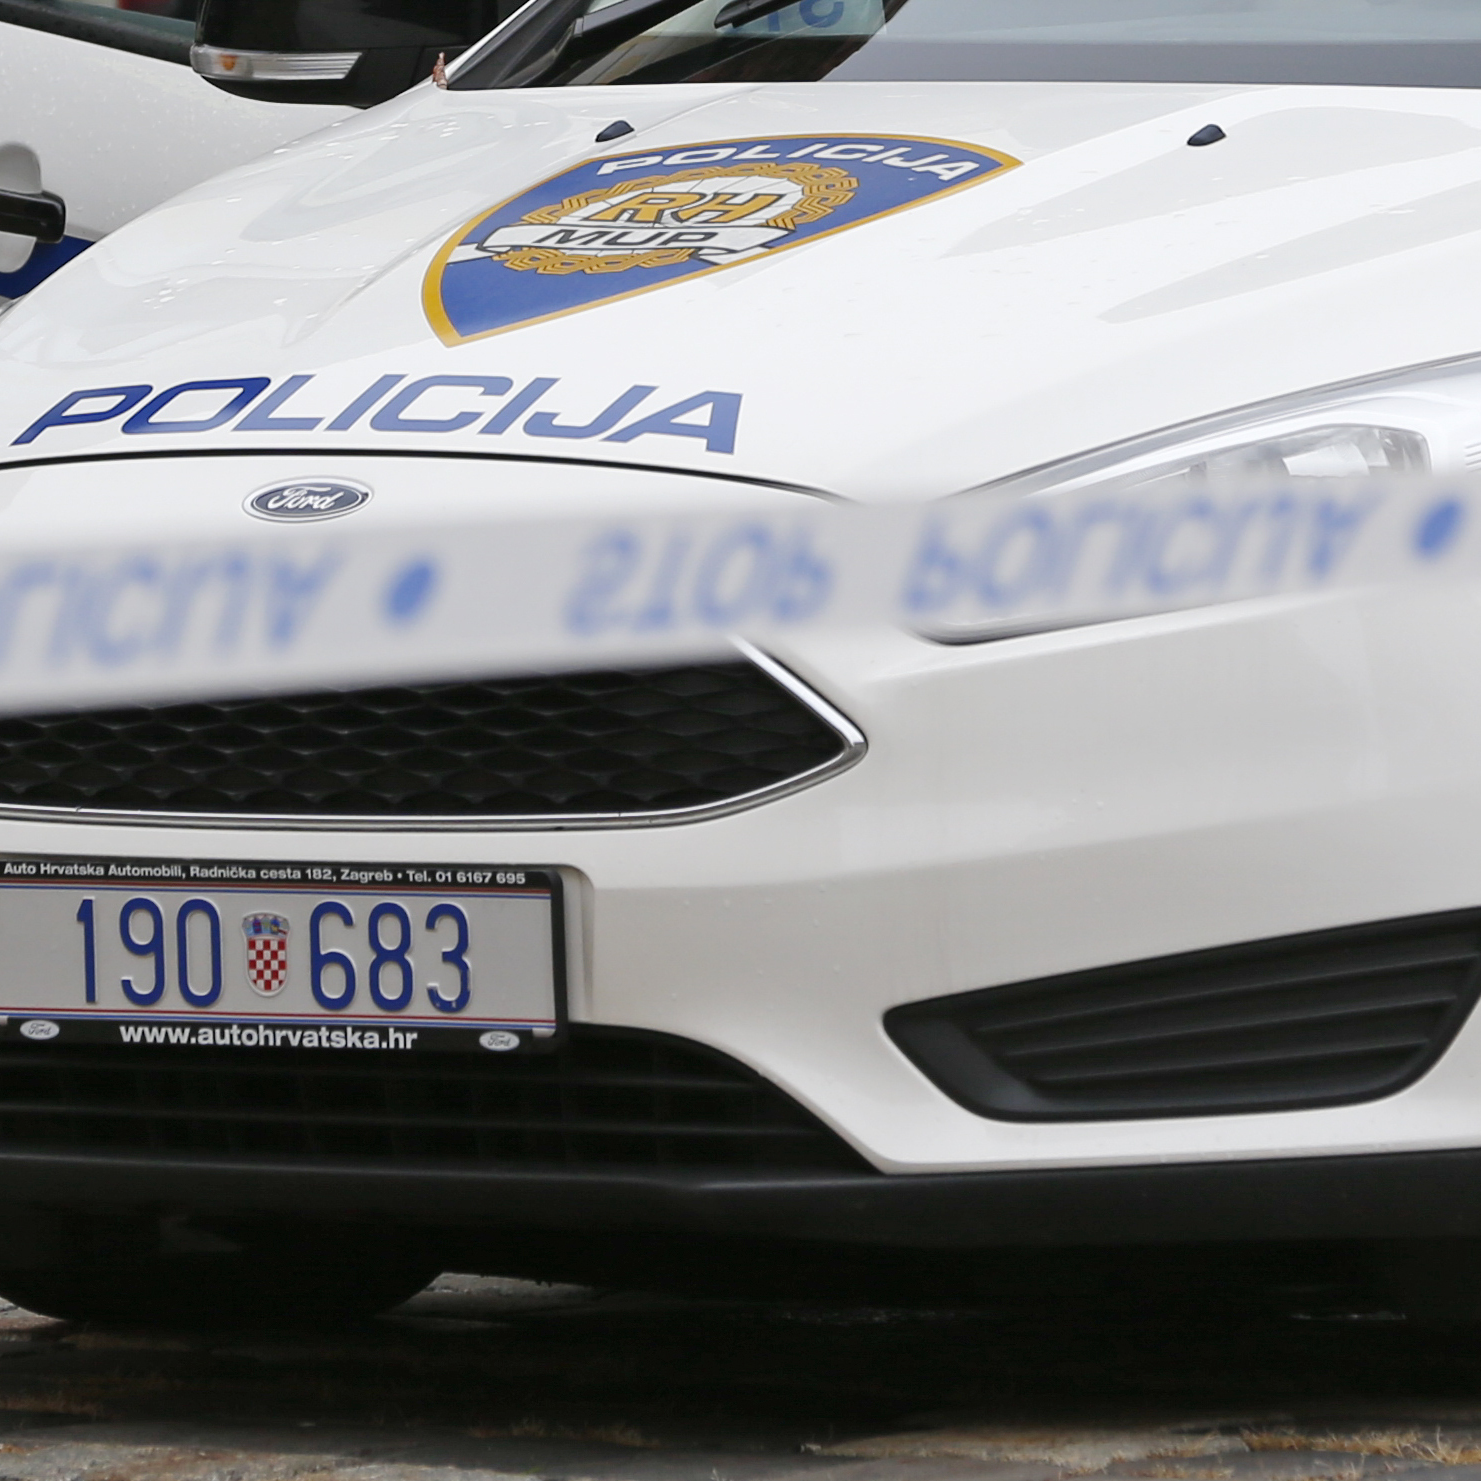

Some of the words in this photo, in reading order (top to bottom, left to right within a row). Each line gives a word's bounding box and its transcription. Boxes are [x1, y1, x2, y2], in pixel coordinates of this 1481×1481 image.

[596, 141, 981, 183] POLICIJA
[596, 192, 784, 225] RH
[533, 228, 719, 250] MUP
[9, 374, 743, 456] POLICIJA
[267, 485, 345, 510] Ford
[4, 862, 36, 875] Auto
[40, 862, 104, 876] Hrvatska
[108, 863, 185, 879] Automobili,
[190, 864, 255, 878] Radnička
[260, 868, 301, 880] cesta
[305, 868, 337, 882] 182,
[340, 869, 393, 883] Zagreb
[407, 869, 432, 882] Tel.
[436, 871, 452, 883] 01
[456, 871, 491, 884] 6167
[496, 872, 526, 885] 695
[76, 896, 223, 1008] 190
[309, 900, 472, 1013] 683
[120, 1024, 417, 1051] www.autohrvatska.hr
